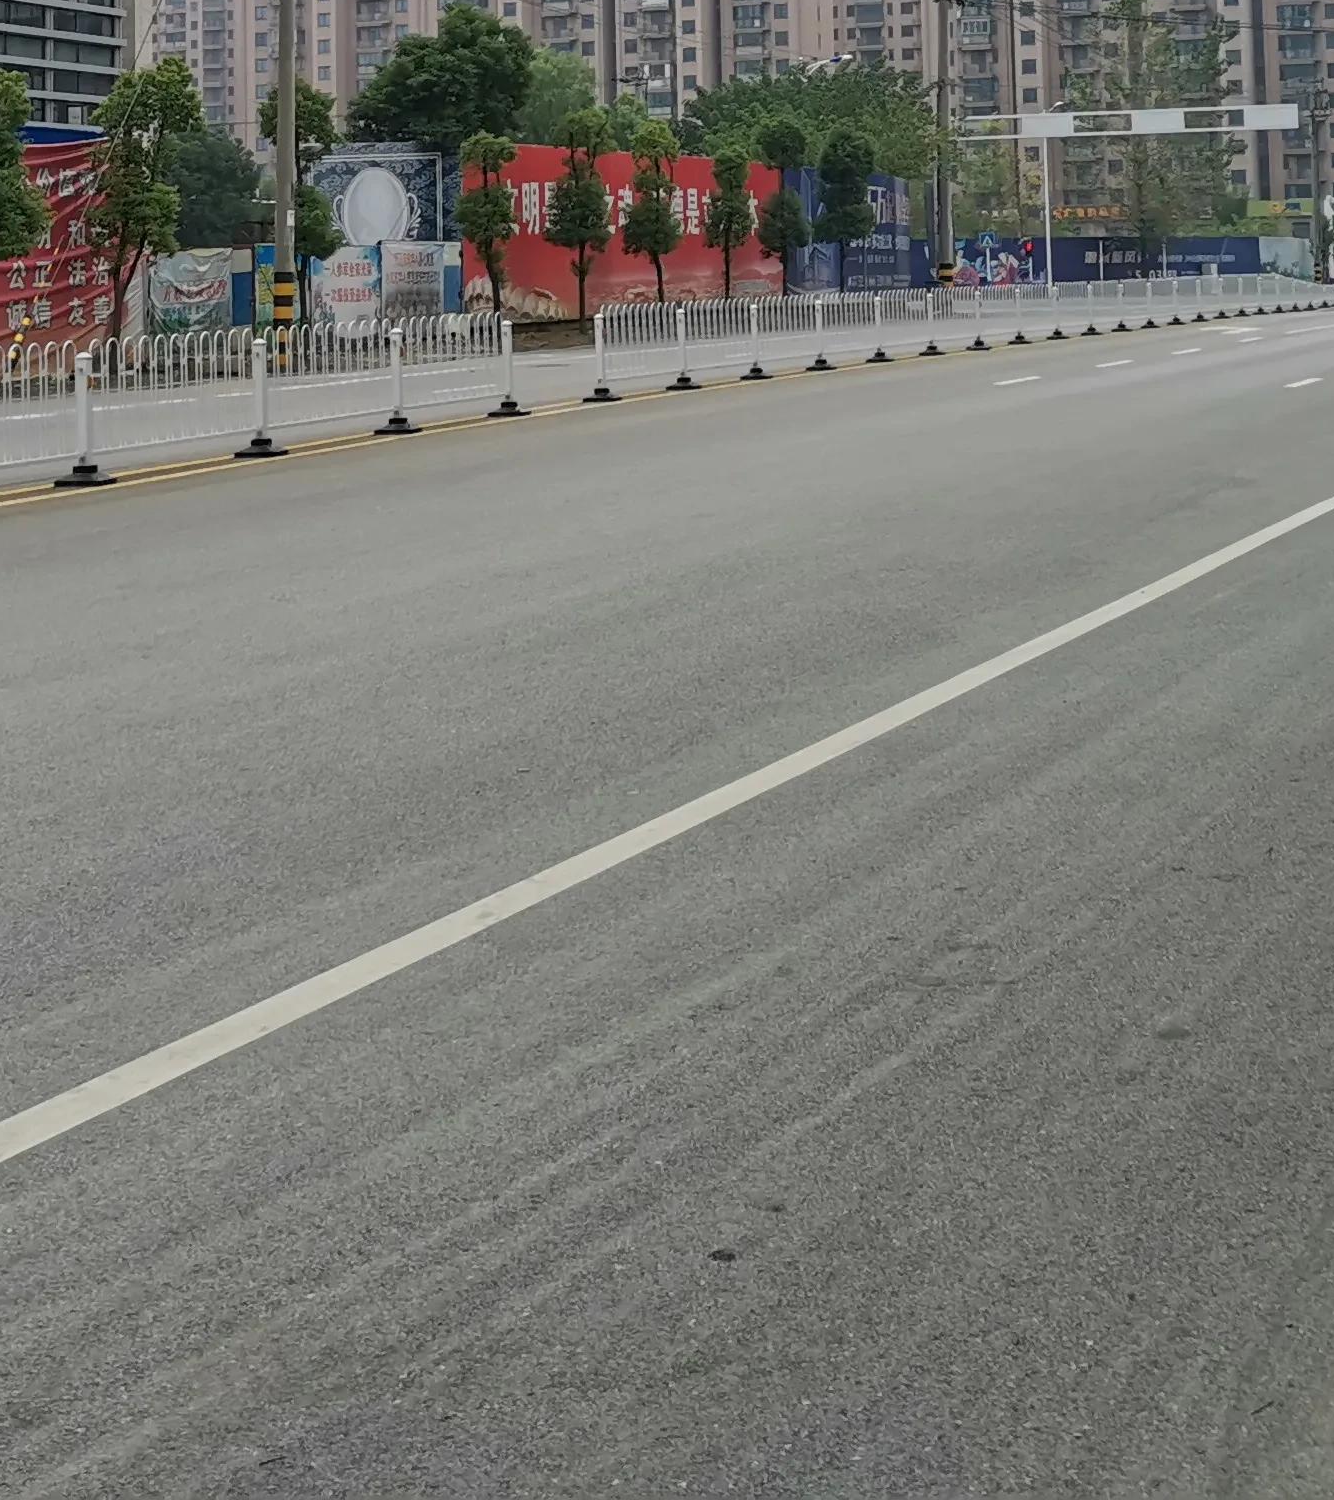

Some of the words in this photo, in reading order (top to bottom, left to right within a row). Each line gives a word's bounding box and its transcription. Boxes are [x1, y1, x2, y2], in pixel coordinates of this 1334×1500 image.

[7, 259, 53, 290] 公正
[69, 256, 112, 287] 法治
[68, 295, 115, 327] 友善
